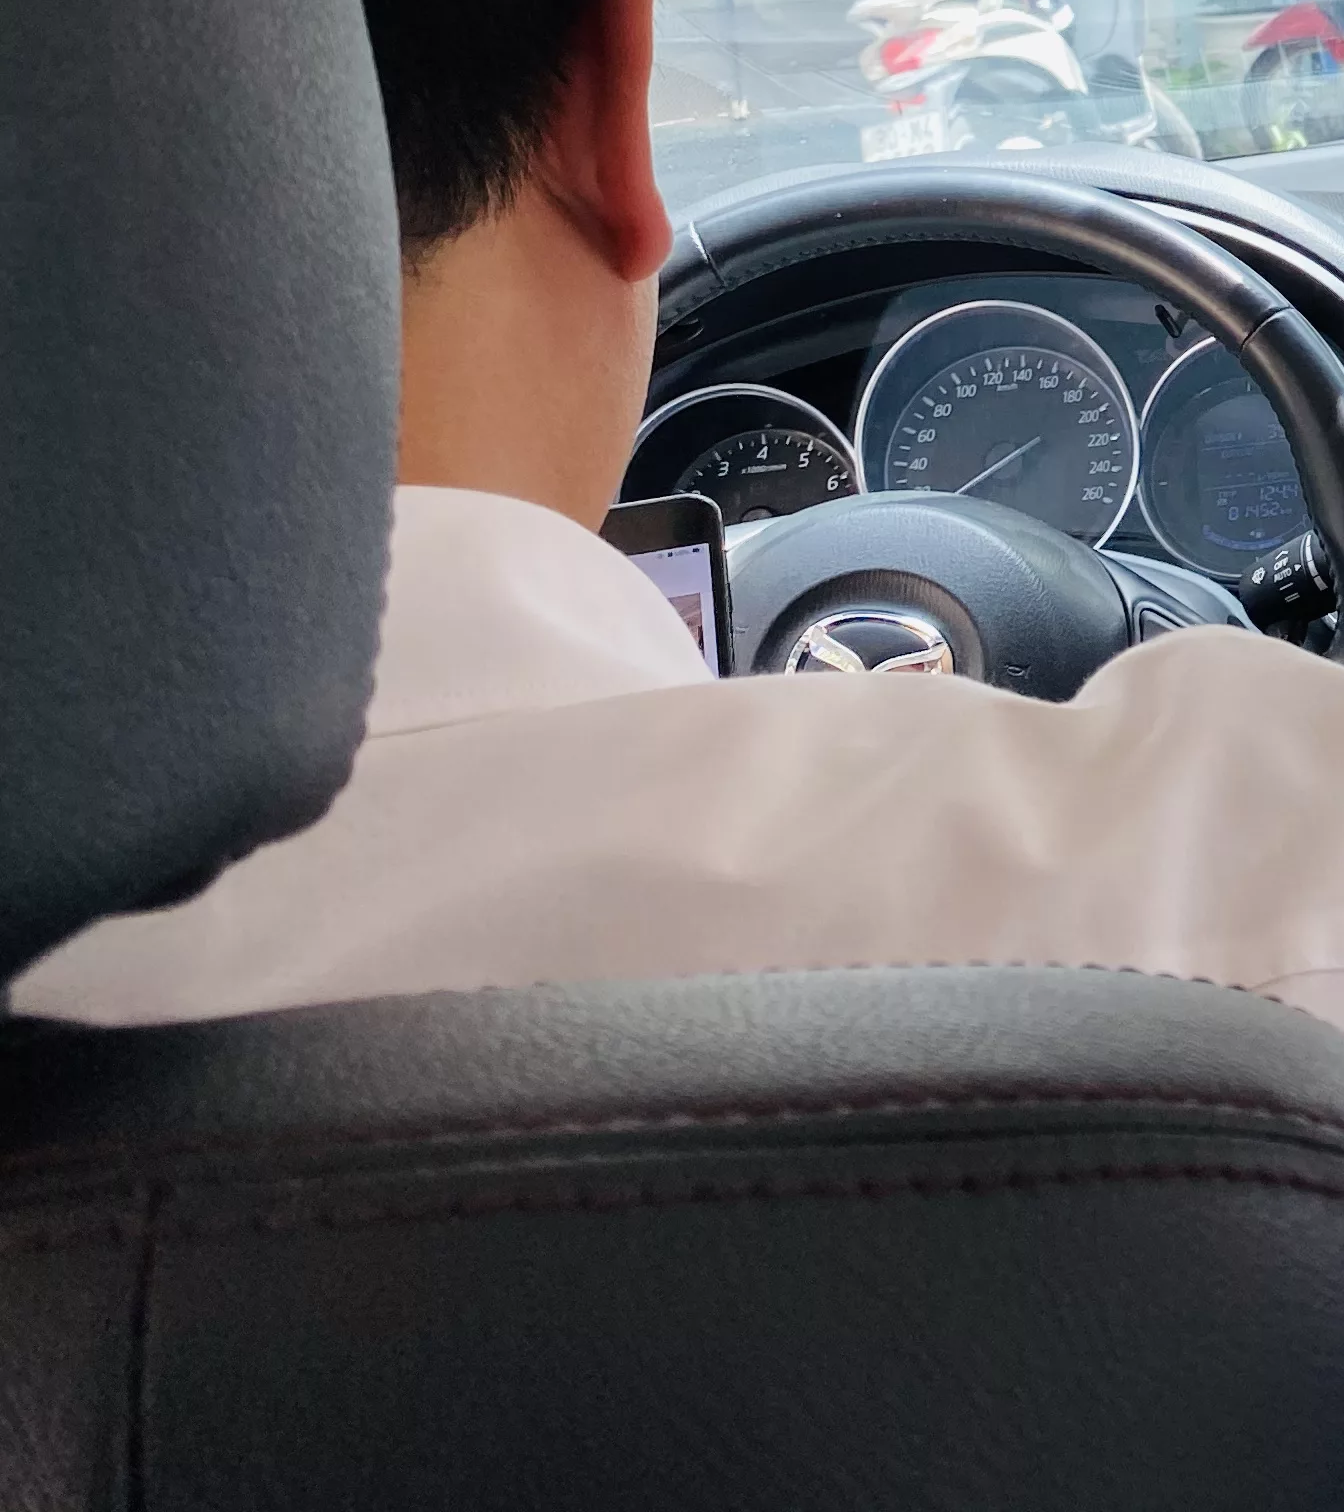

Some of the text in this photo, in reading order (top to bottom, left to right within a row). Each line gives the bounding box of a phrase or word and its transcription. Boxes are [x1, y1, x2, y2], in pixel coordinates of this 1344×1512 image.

[983, 371, 1004, 386] 120
[1012, 368, 1033, 383] 140
[1039, 375, 1060, 390] 160
[956, 384, 977, 399] 100
[1063, 389, 1083, 404] 180
[933, 403, 952, 418] 80
[1078, 409, 1101, 424] 200
[917, 428, 936, 443] 60
[1087, 433, 1110, 448] 220
[756, 446, 769, 460] 4
[798, 452, 810, 468] 5
[717, 461, 729, 477] 3
[909, 457, 929, 471] 40
[1089, 460, 1111, 474] 240
[827, 474, 839, 491] 6
[1081, 486, 1104, 501] 260
[1273, 556, 1289, 571] OFF
[1273, 567, 1292, 583] AUTO
